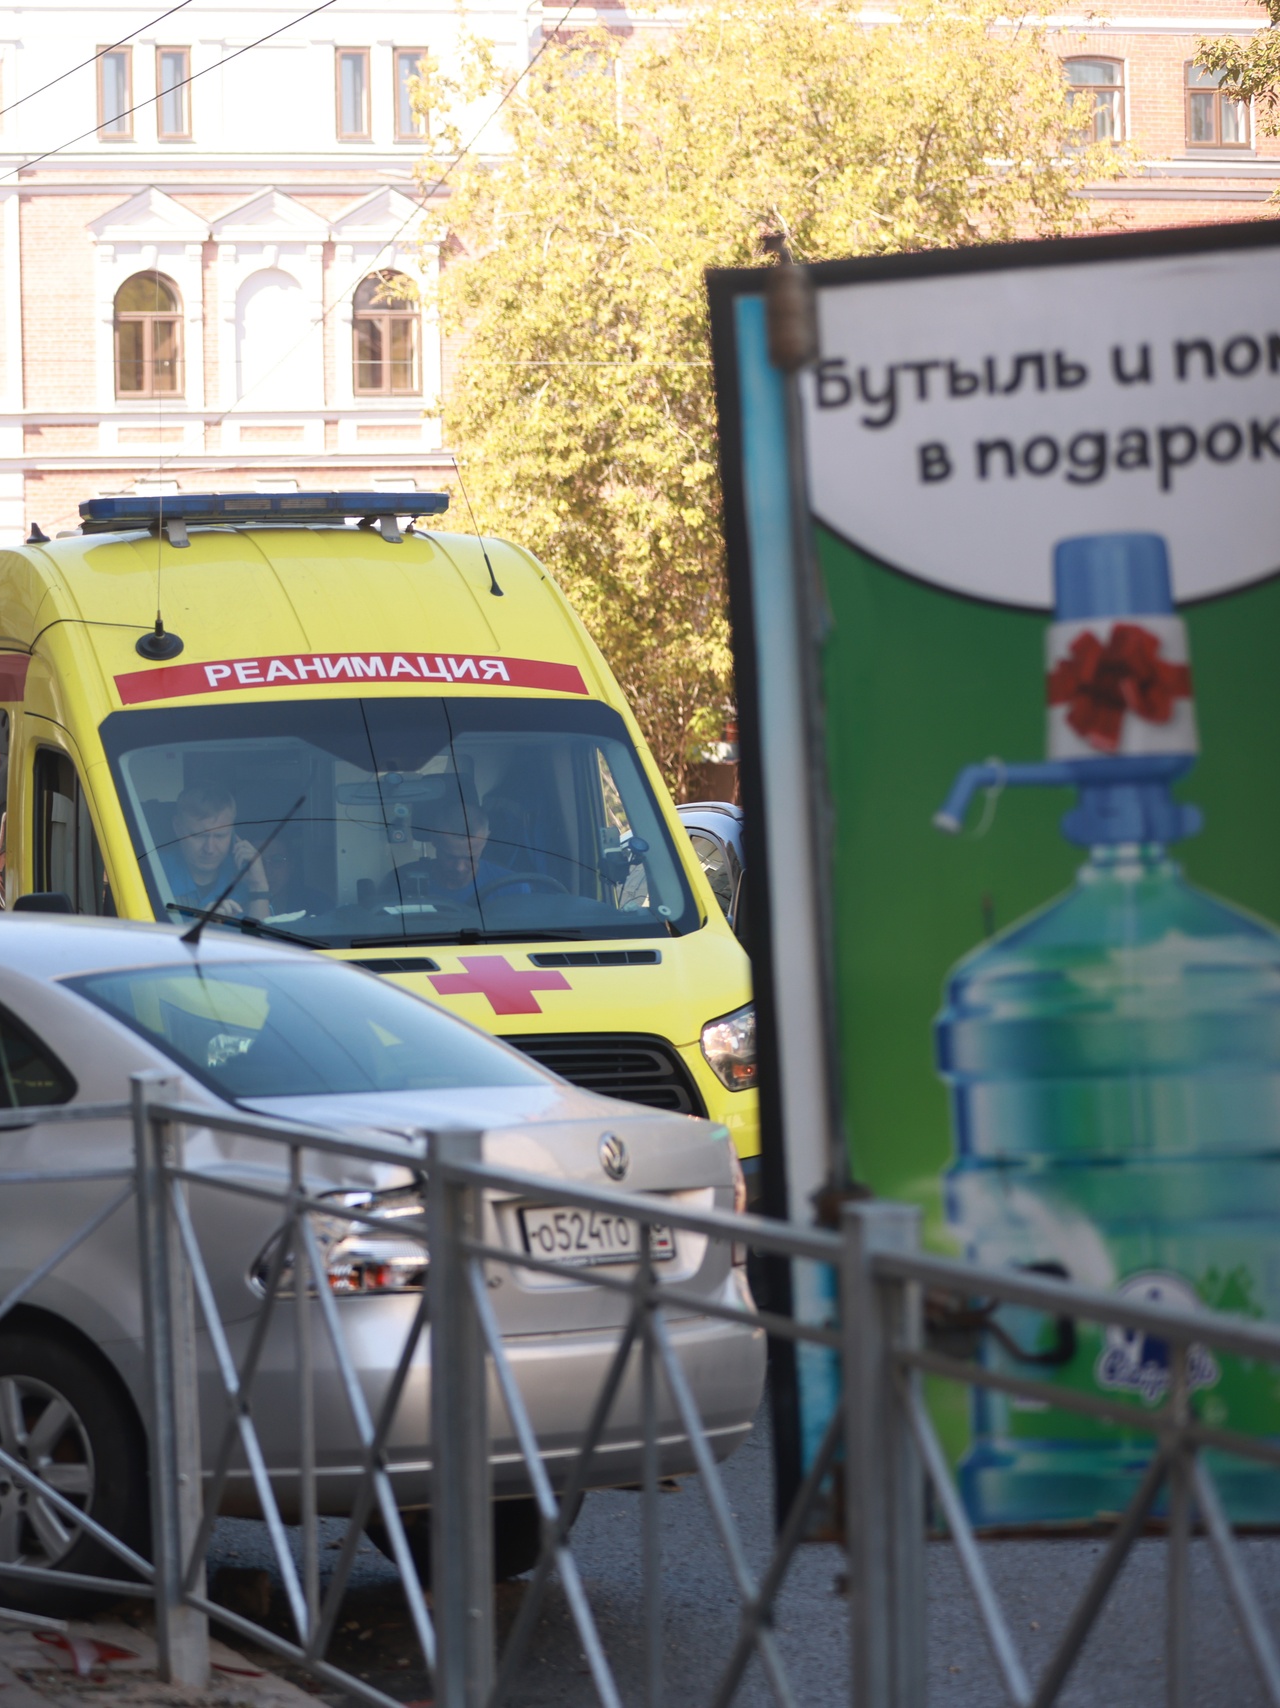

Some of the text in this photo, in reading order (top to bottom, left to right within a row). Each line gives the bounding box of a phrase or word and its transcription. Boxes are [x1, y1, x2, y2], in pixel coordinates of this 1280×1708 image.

[814, 331, 1280, 429] Бутыль и по
[918, 416, 1280, 494] в подарок
[204, 655, 510, 687] РЕАНИМАЦИЯ
